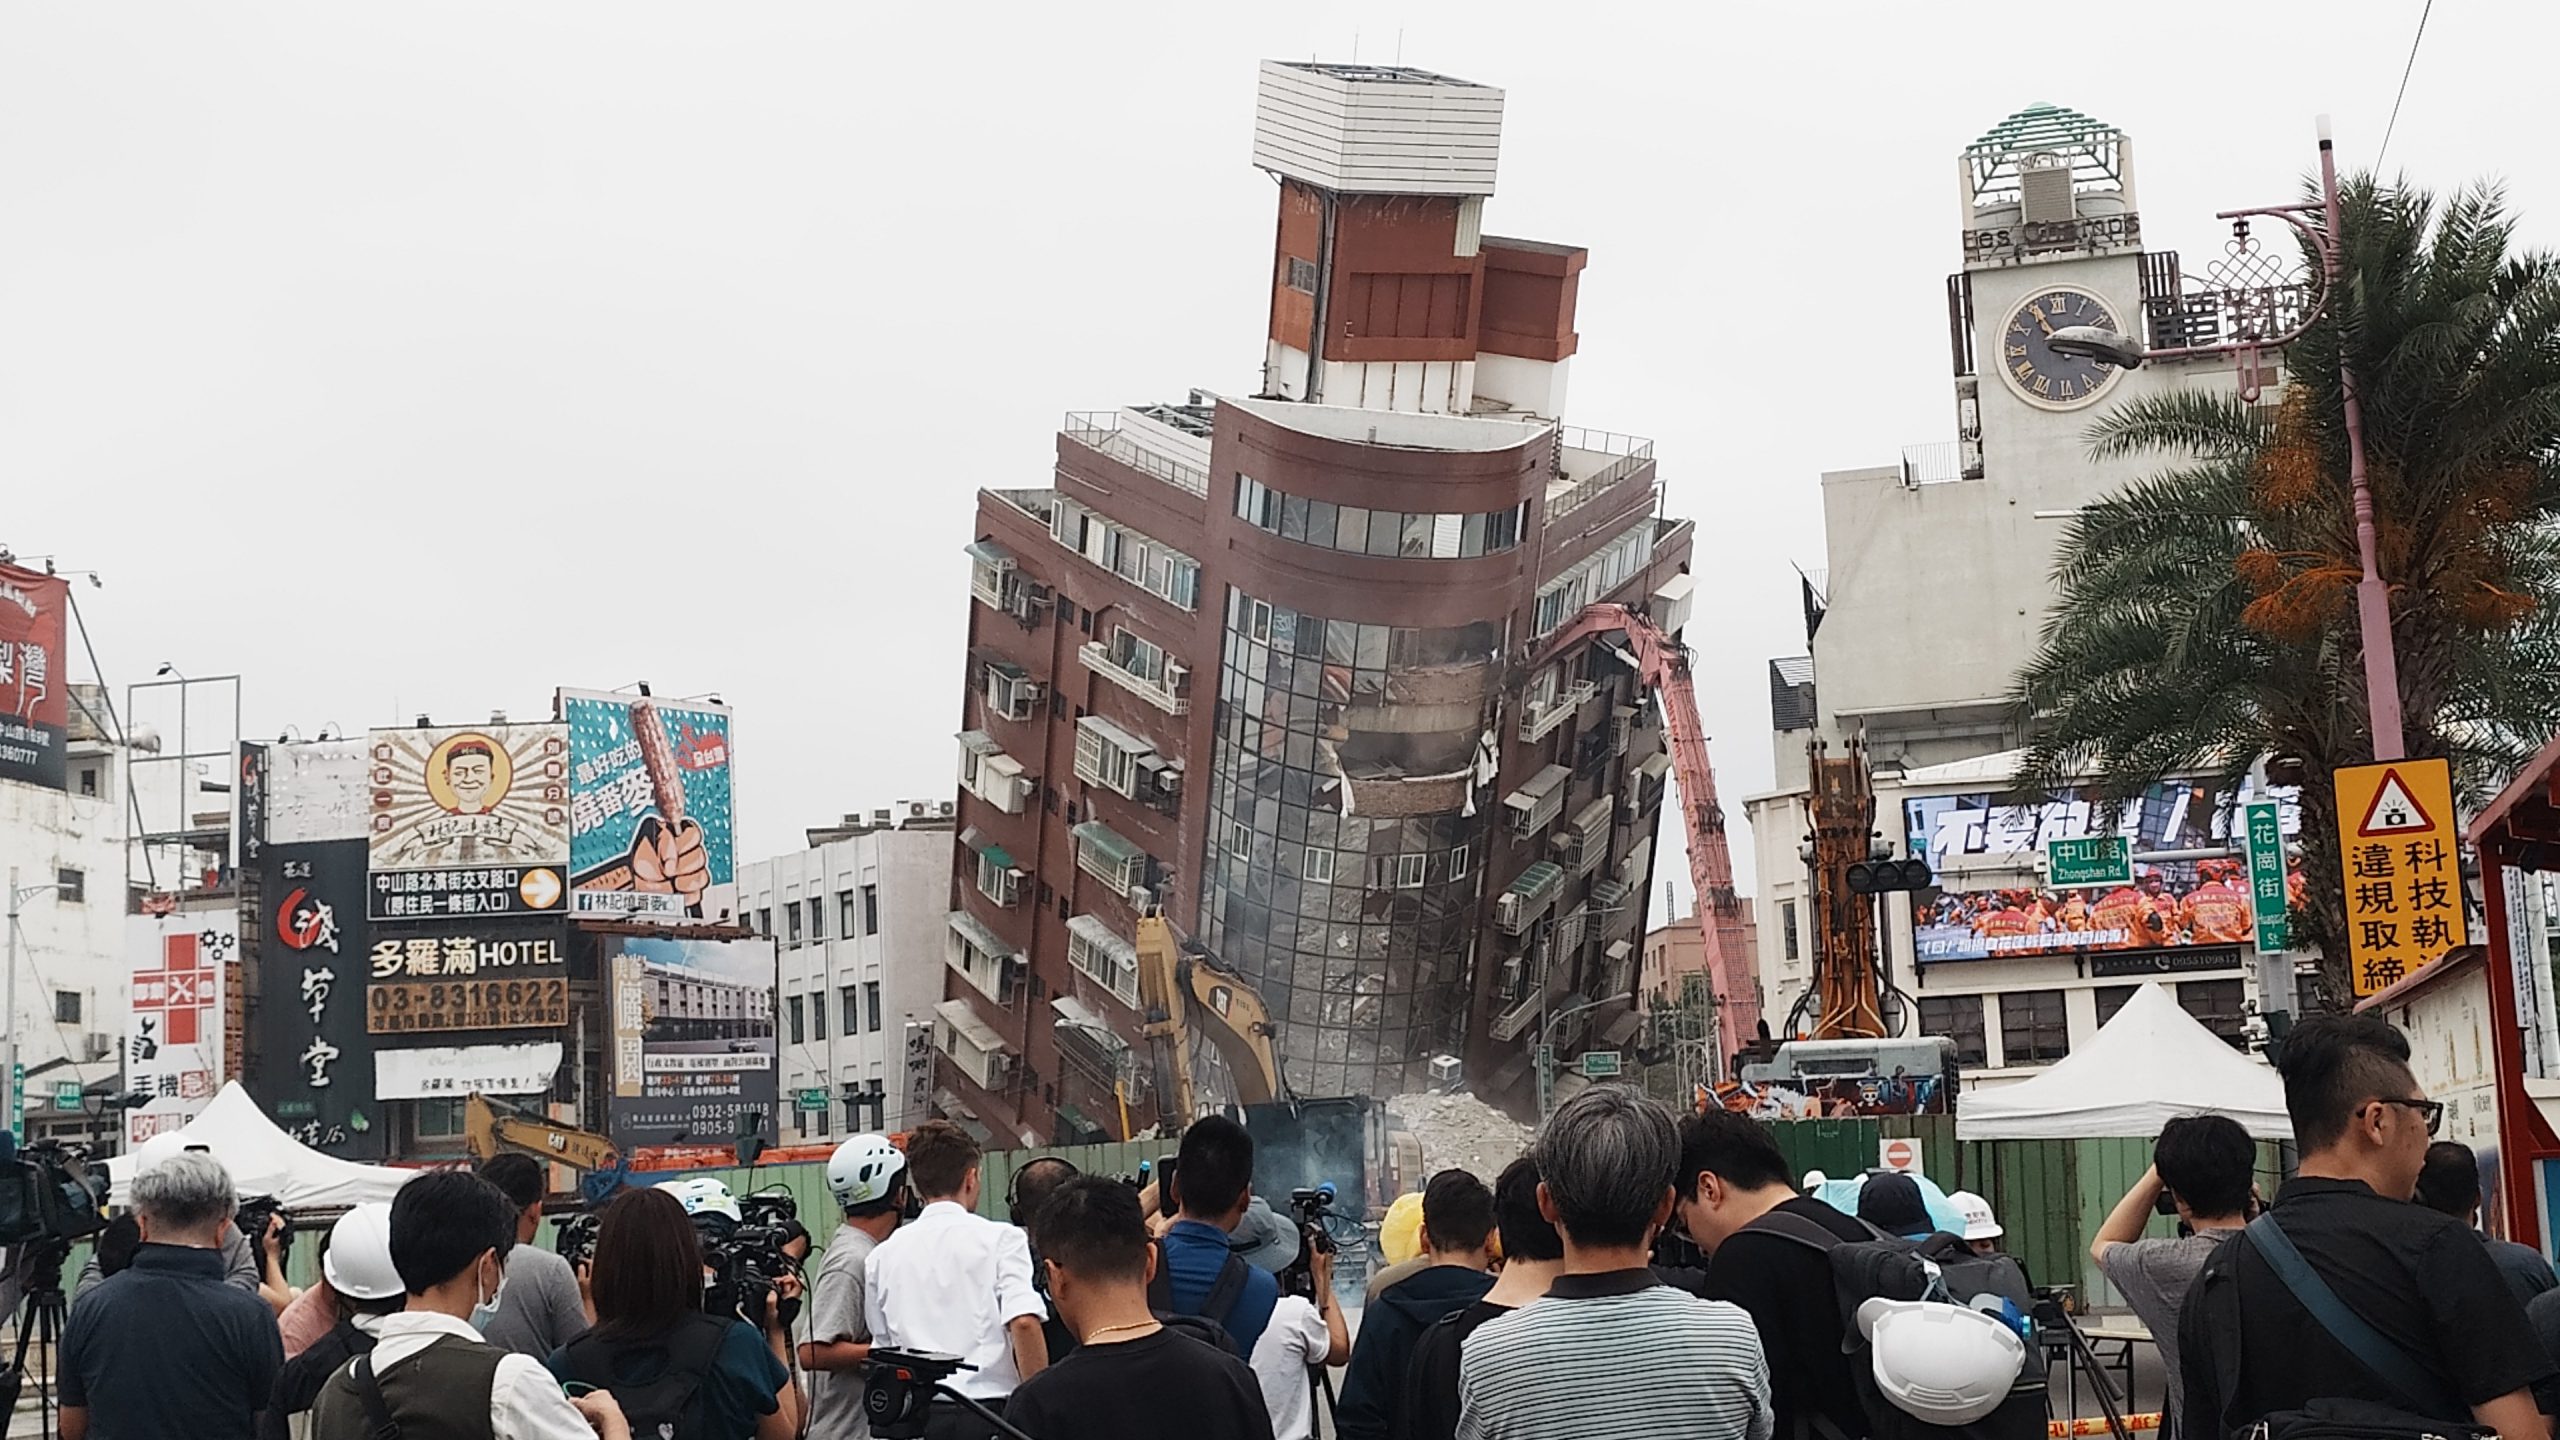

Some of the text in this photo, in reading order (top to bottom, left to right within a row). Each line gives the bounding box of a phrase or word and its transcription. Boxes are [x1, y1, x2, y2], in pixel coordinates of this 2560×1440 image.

[0, 744, 38, 765] 360777
[576, 740, 643, 785] 最好吃的
[2253, 824, 2280, 898] 花崗街
[376, 869, 518, 893] 中山路北濱街交叉路口
[384, 892, 510, 916] (原住民一條街入口)
[2352, 843, 2405, 990] 違規取締
[2404, 839, 2455, 968] 科技執
[369, 936, 564, 978] 多羅滿 HOTEL
[372, 980, 564, 1012] 03-8316622
[133, 1070, 217, 1099] 手機急
